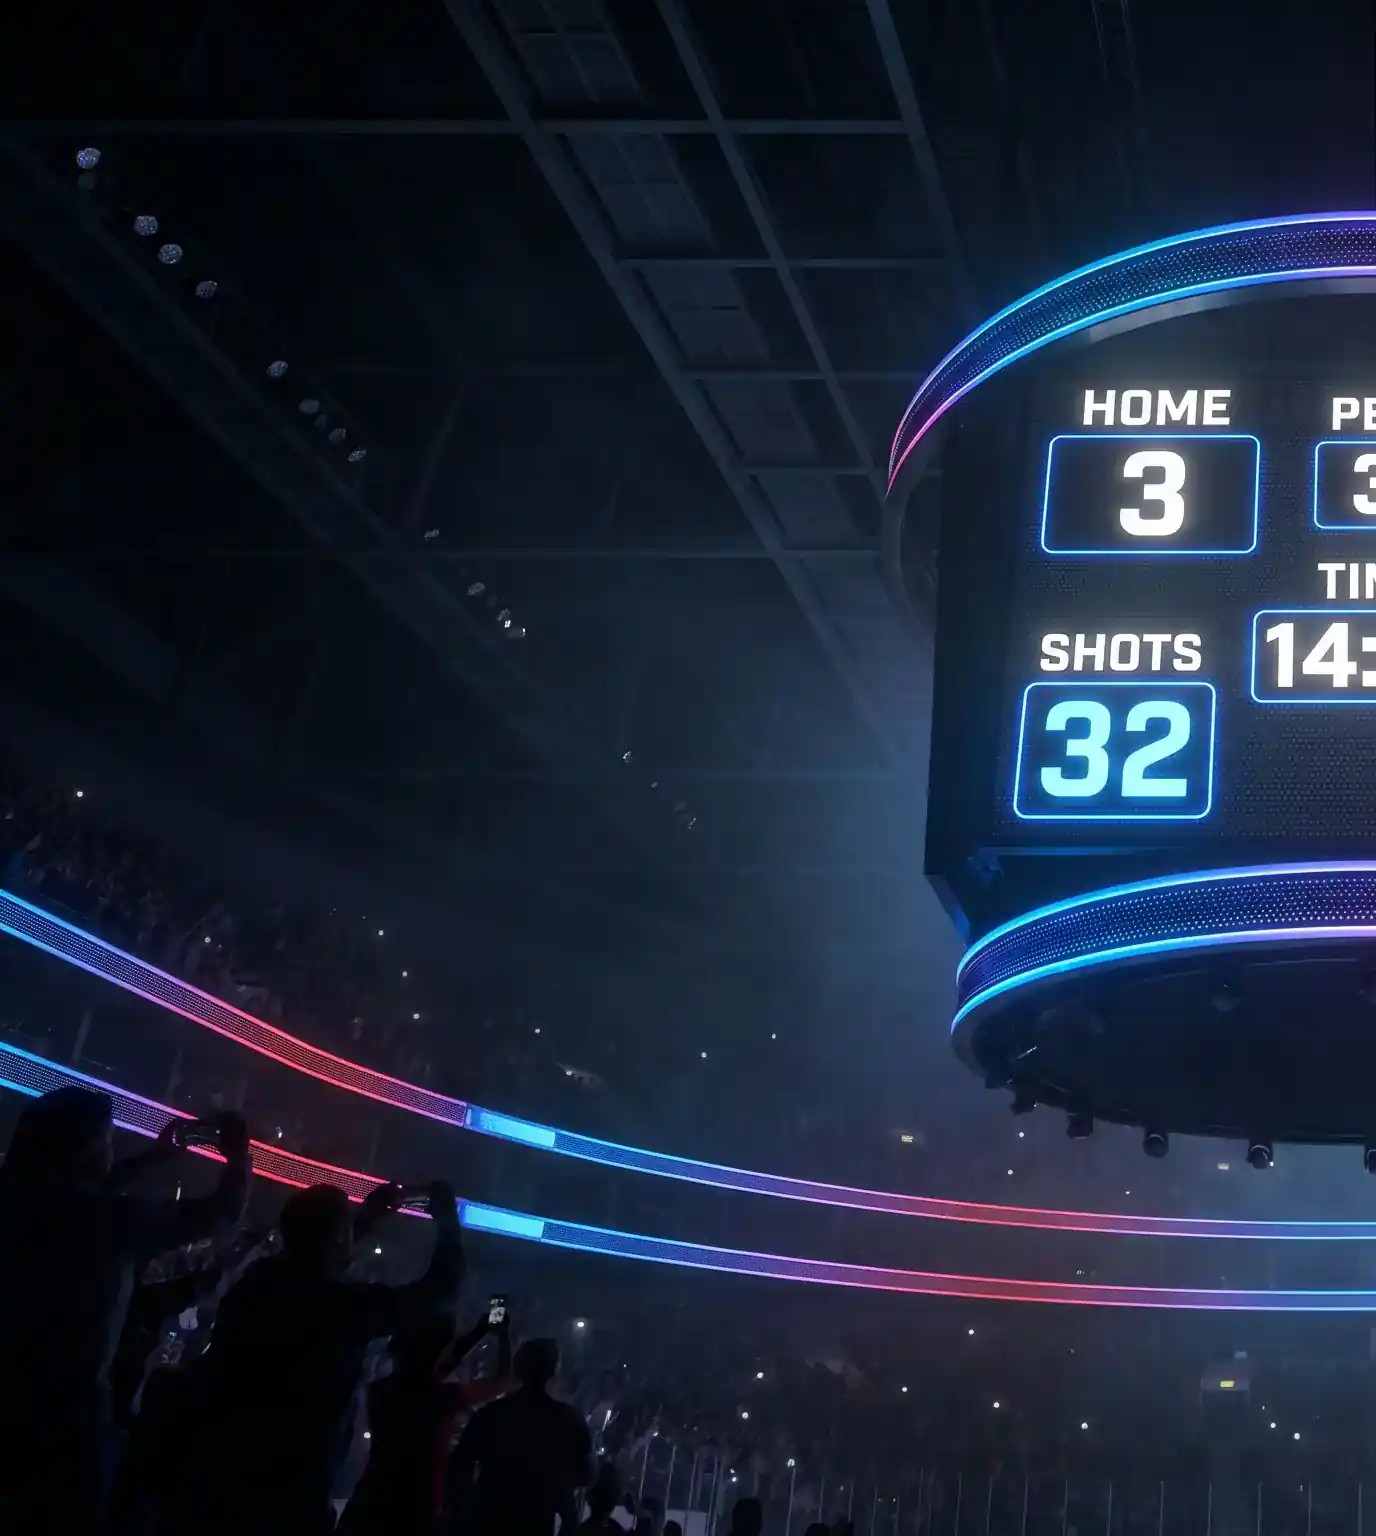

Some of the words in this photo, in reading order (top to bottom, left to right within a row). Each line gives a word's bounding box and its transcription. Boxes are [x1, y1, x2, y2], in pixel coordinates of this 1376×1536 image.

[1083, 389, 1232, 426] HOME
[1119, 450, 1186, 537] 3
[1040, 633, 1202, 672] SHOTS
[1040, 700, 1191, 798] 32
